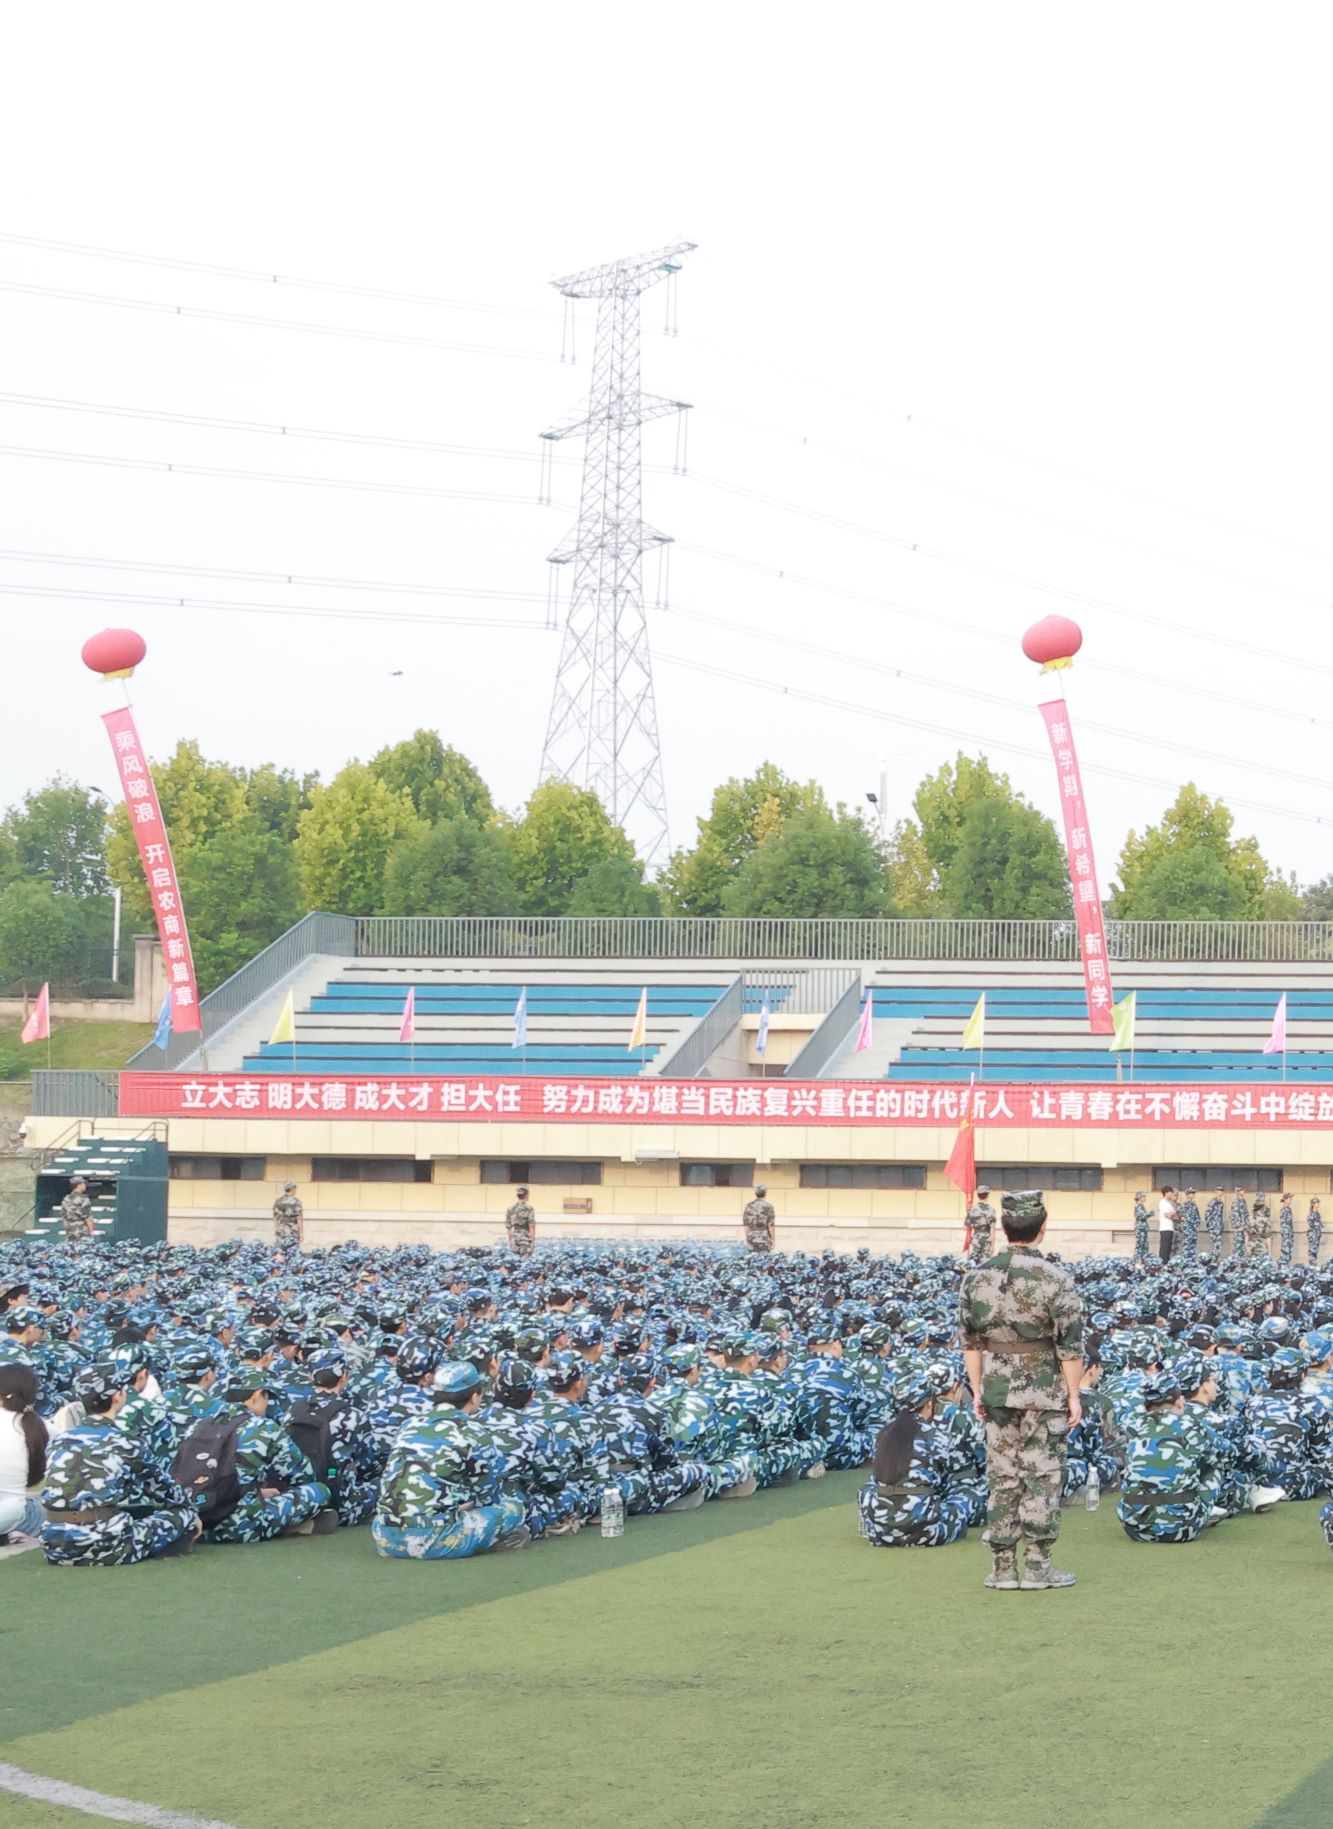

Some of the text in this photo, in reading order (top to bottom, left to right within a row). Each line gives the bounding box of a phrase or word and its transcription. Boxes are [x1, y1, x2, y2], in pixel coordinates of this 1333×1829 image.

[115, 730, 194, 1006] 乘风破浪 开启农商新篇章
[182, 1082, 261, 1108] 立大志
[268, 1083, 346, 1110] 明大德
[354, 1083, 434, 1111] 成大才
[441, 1083, 521, 1113] 担大任
[543, 1084, 1014, 1119] 努力成为堪当民族复兴重任的时代新人
